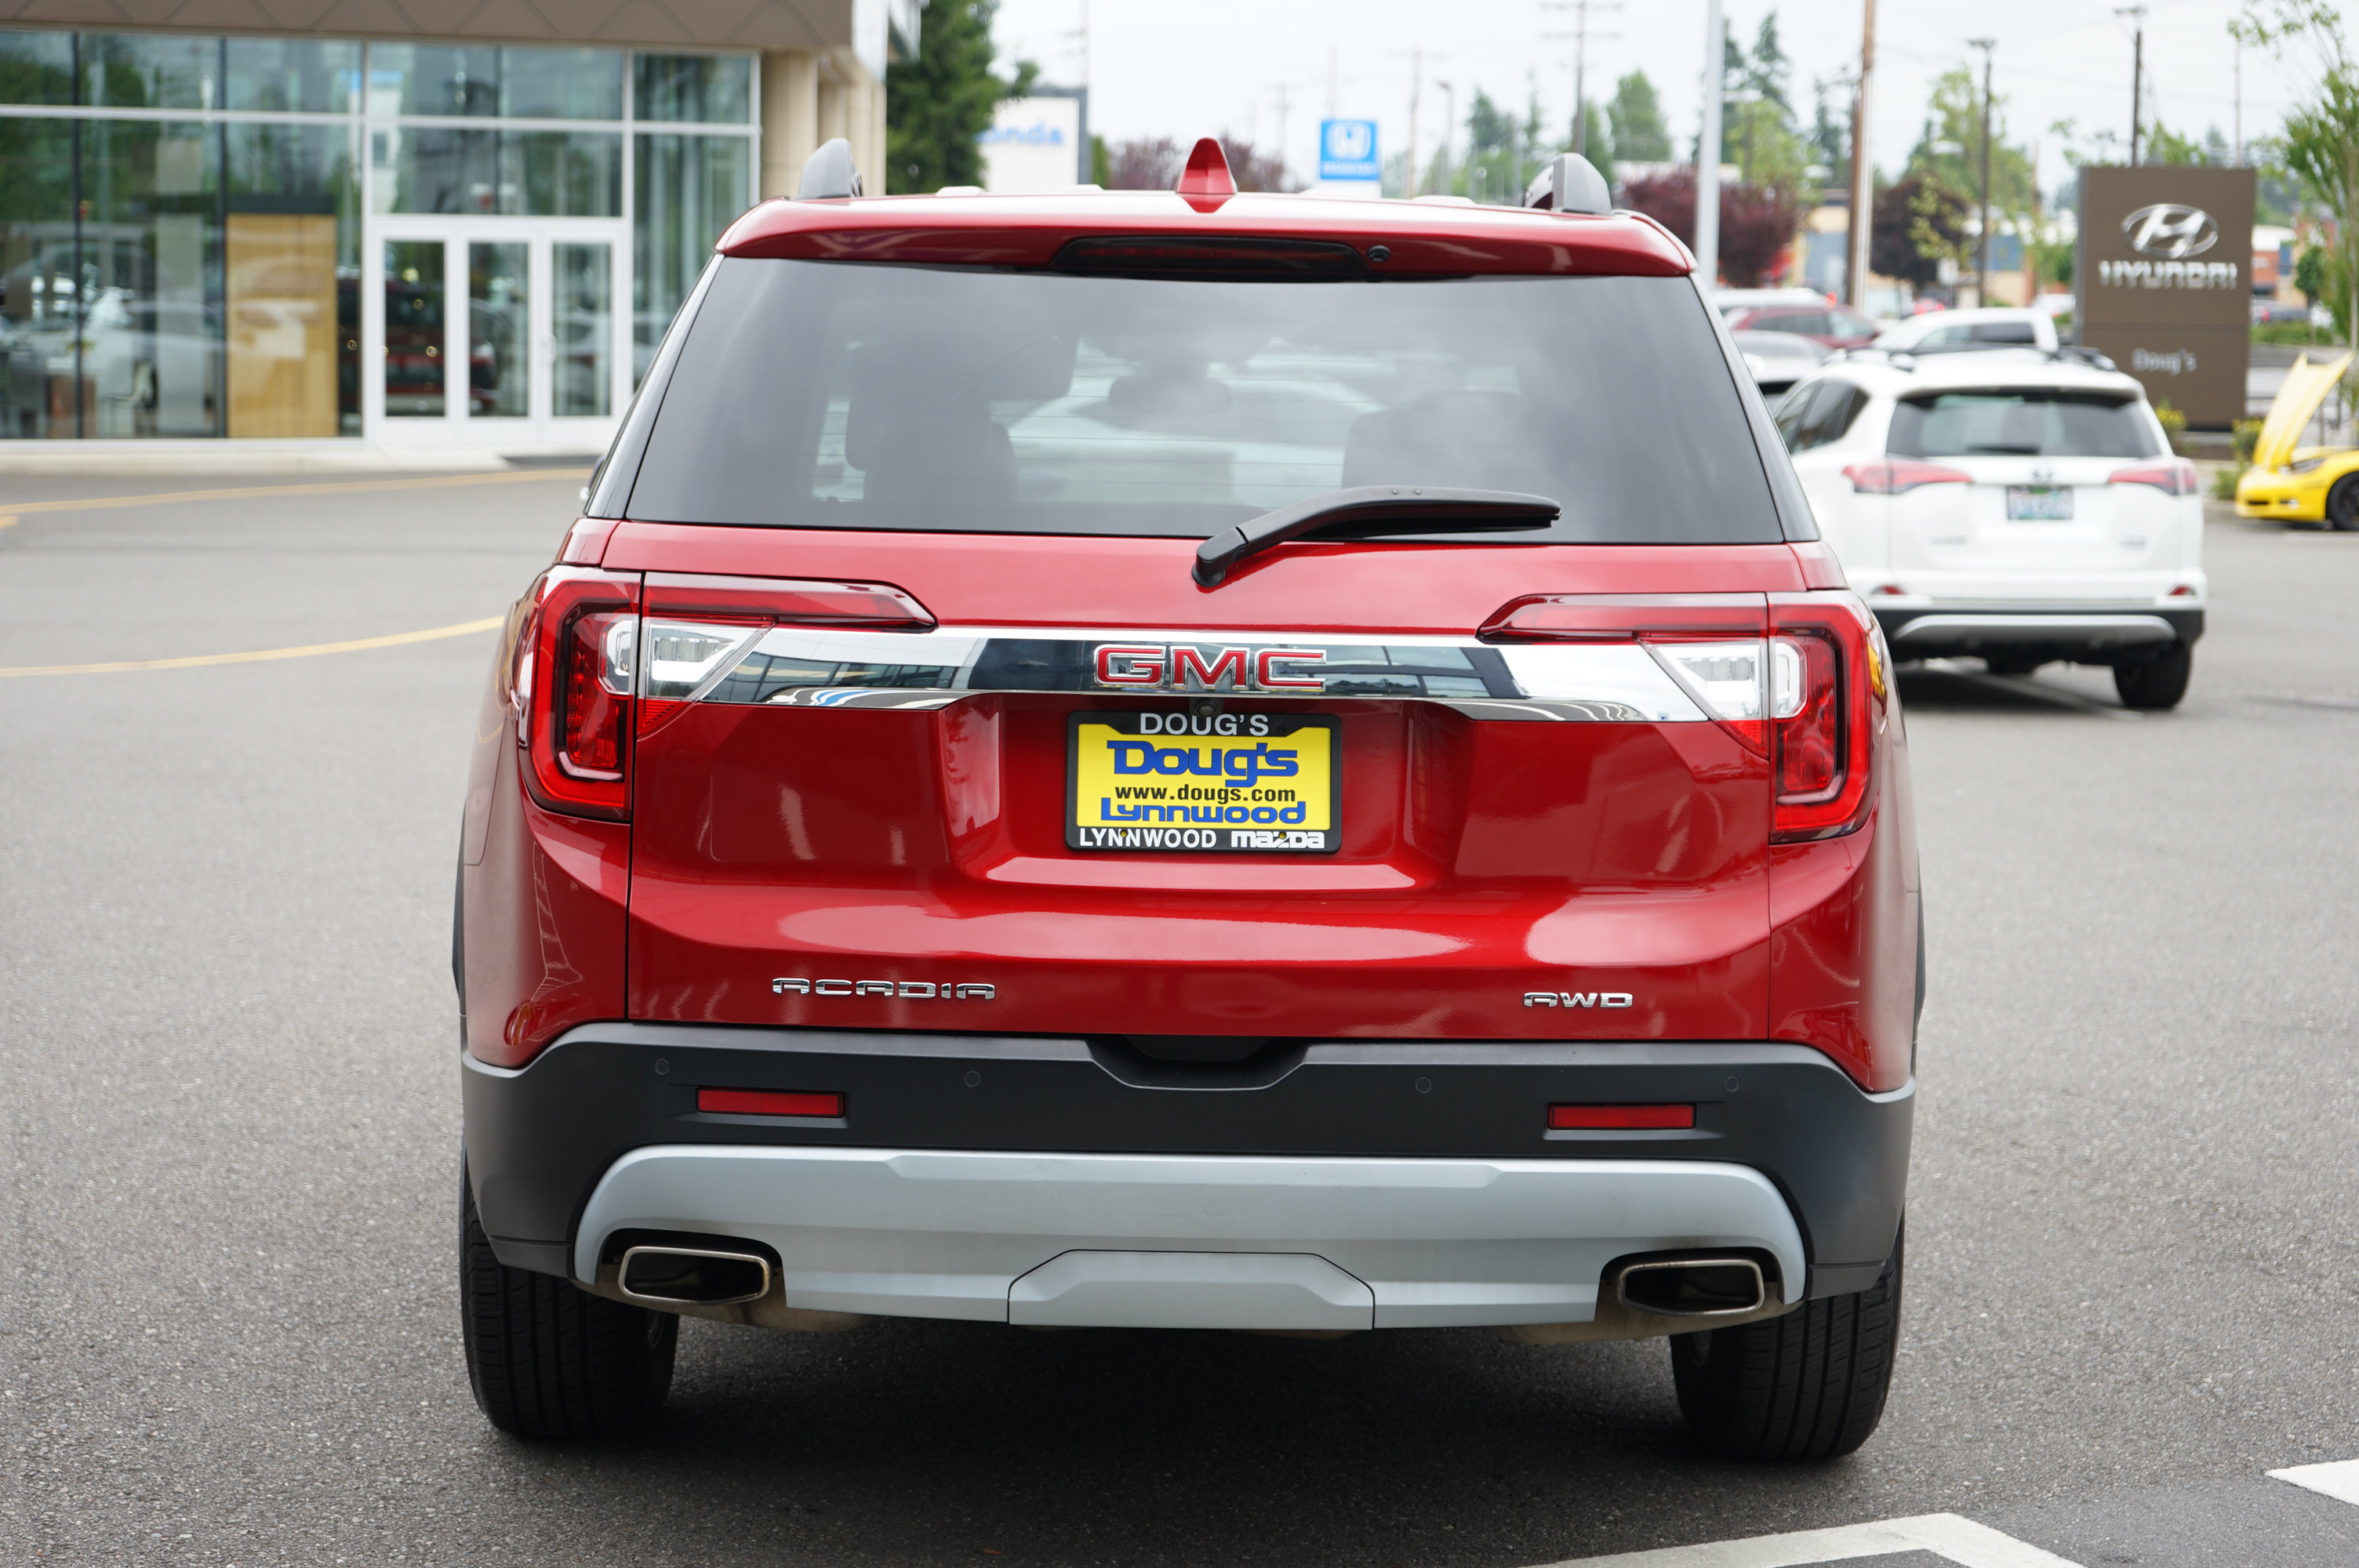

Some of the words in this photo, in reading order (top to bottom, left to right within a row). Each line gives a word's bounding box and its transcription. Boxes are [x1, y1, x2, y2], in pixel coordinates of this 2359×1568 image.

[2099, 260, 2237, 289] HYUNDAI
[2132, 348, 2197, 376] Doug's
[1093, 644, 1327, 691] GMC
[1140, 713, 1269, 736] DOUG'S
[1107, 740, 1299, 788] Doug's
[1114, 784, 1296, 804] www.dougs.com
[1100, 797, 1307, 824] Lynnwood
[1079, 827, 1217, 848] LYNNWOOD
[772, 978, 995, 1000] ACADIA
[1524, 992, 1634, 1008] AWD
